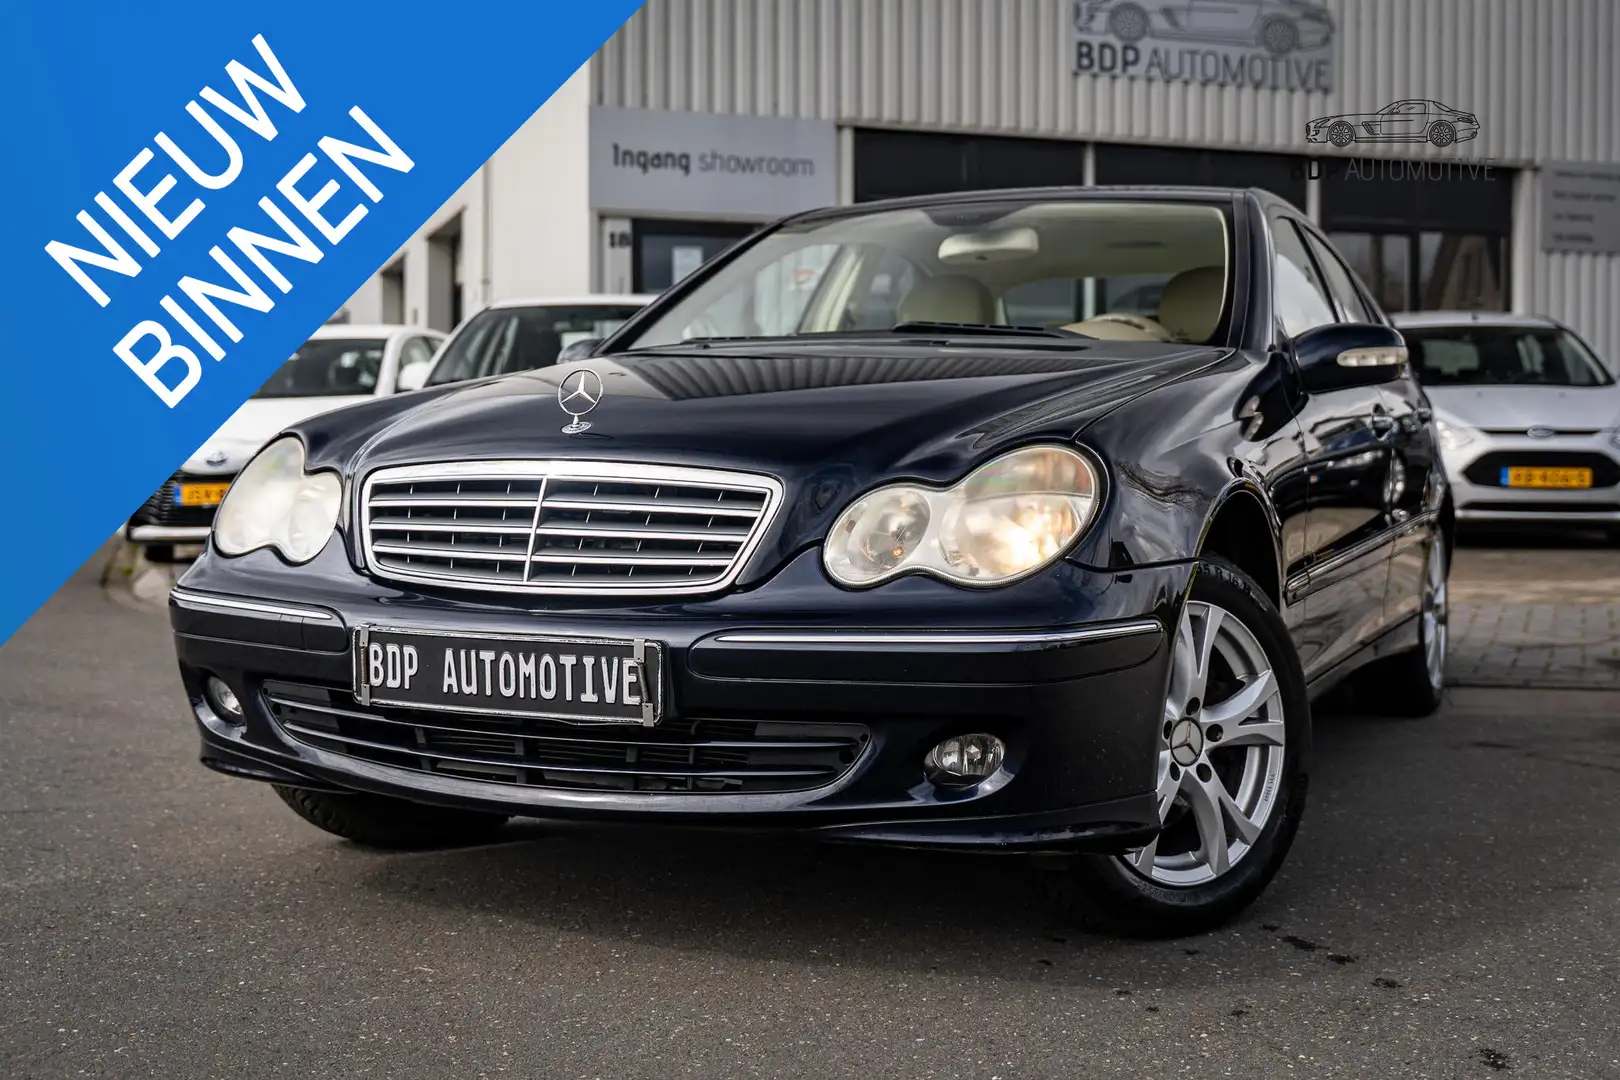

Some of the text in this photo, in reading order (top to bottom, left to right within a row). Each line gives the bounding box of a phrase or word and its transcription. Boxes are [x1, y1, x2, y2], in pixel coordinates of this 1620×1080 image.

[1077, 42, 1330, 89] BDP AUTOMOTIVE
[612, 142, 815, 177] Ingang showroom
[369, 643, 642, 704] BDP AUTOMOTIVE
